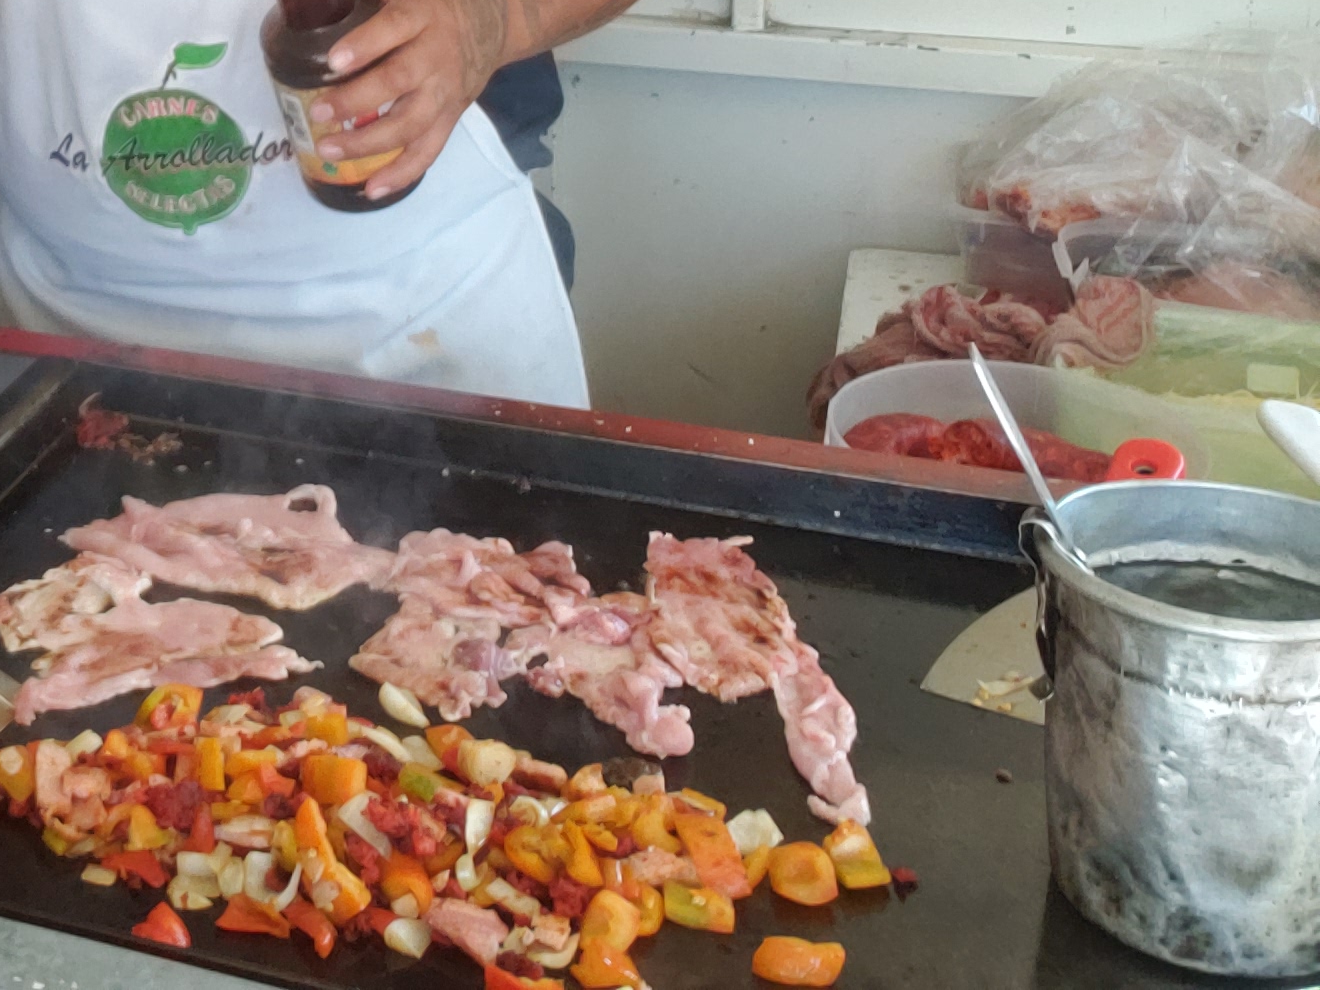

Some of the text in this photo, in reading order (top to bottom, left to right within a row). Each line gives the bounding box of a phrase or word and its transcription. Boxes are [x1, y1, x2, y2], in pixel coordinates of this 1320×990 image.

[119, 95, 220, 128] CARNES
[49, 130, 294, 176] La Arrollador
[126, 175, 236, 214] SELECTAS
